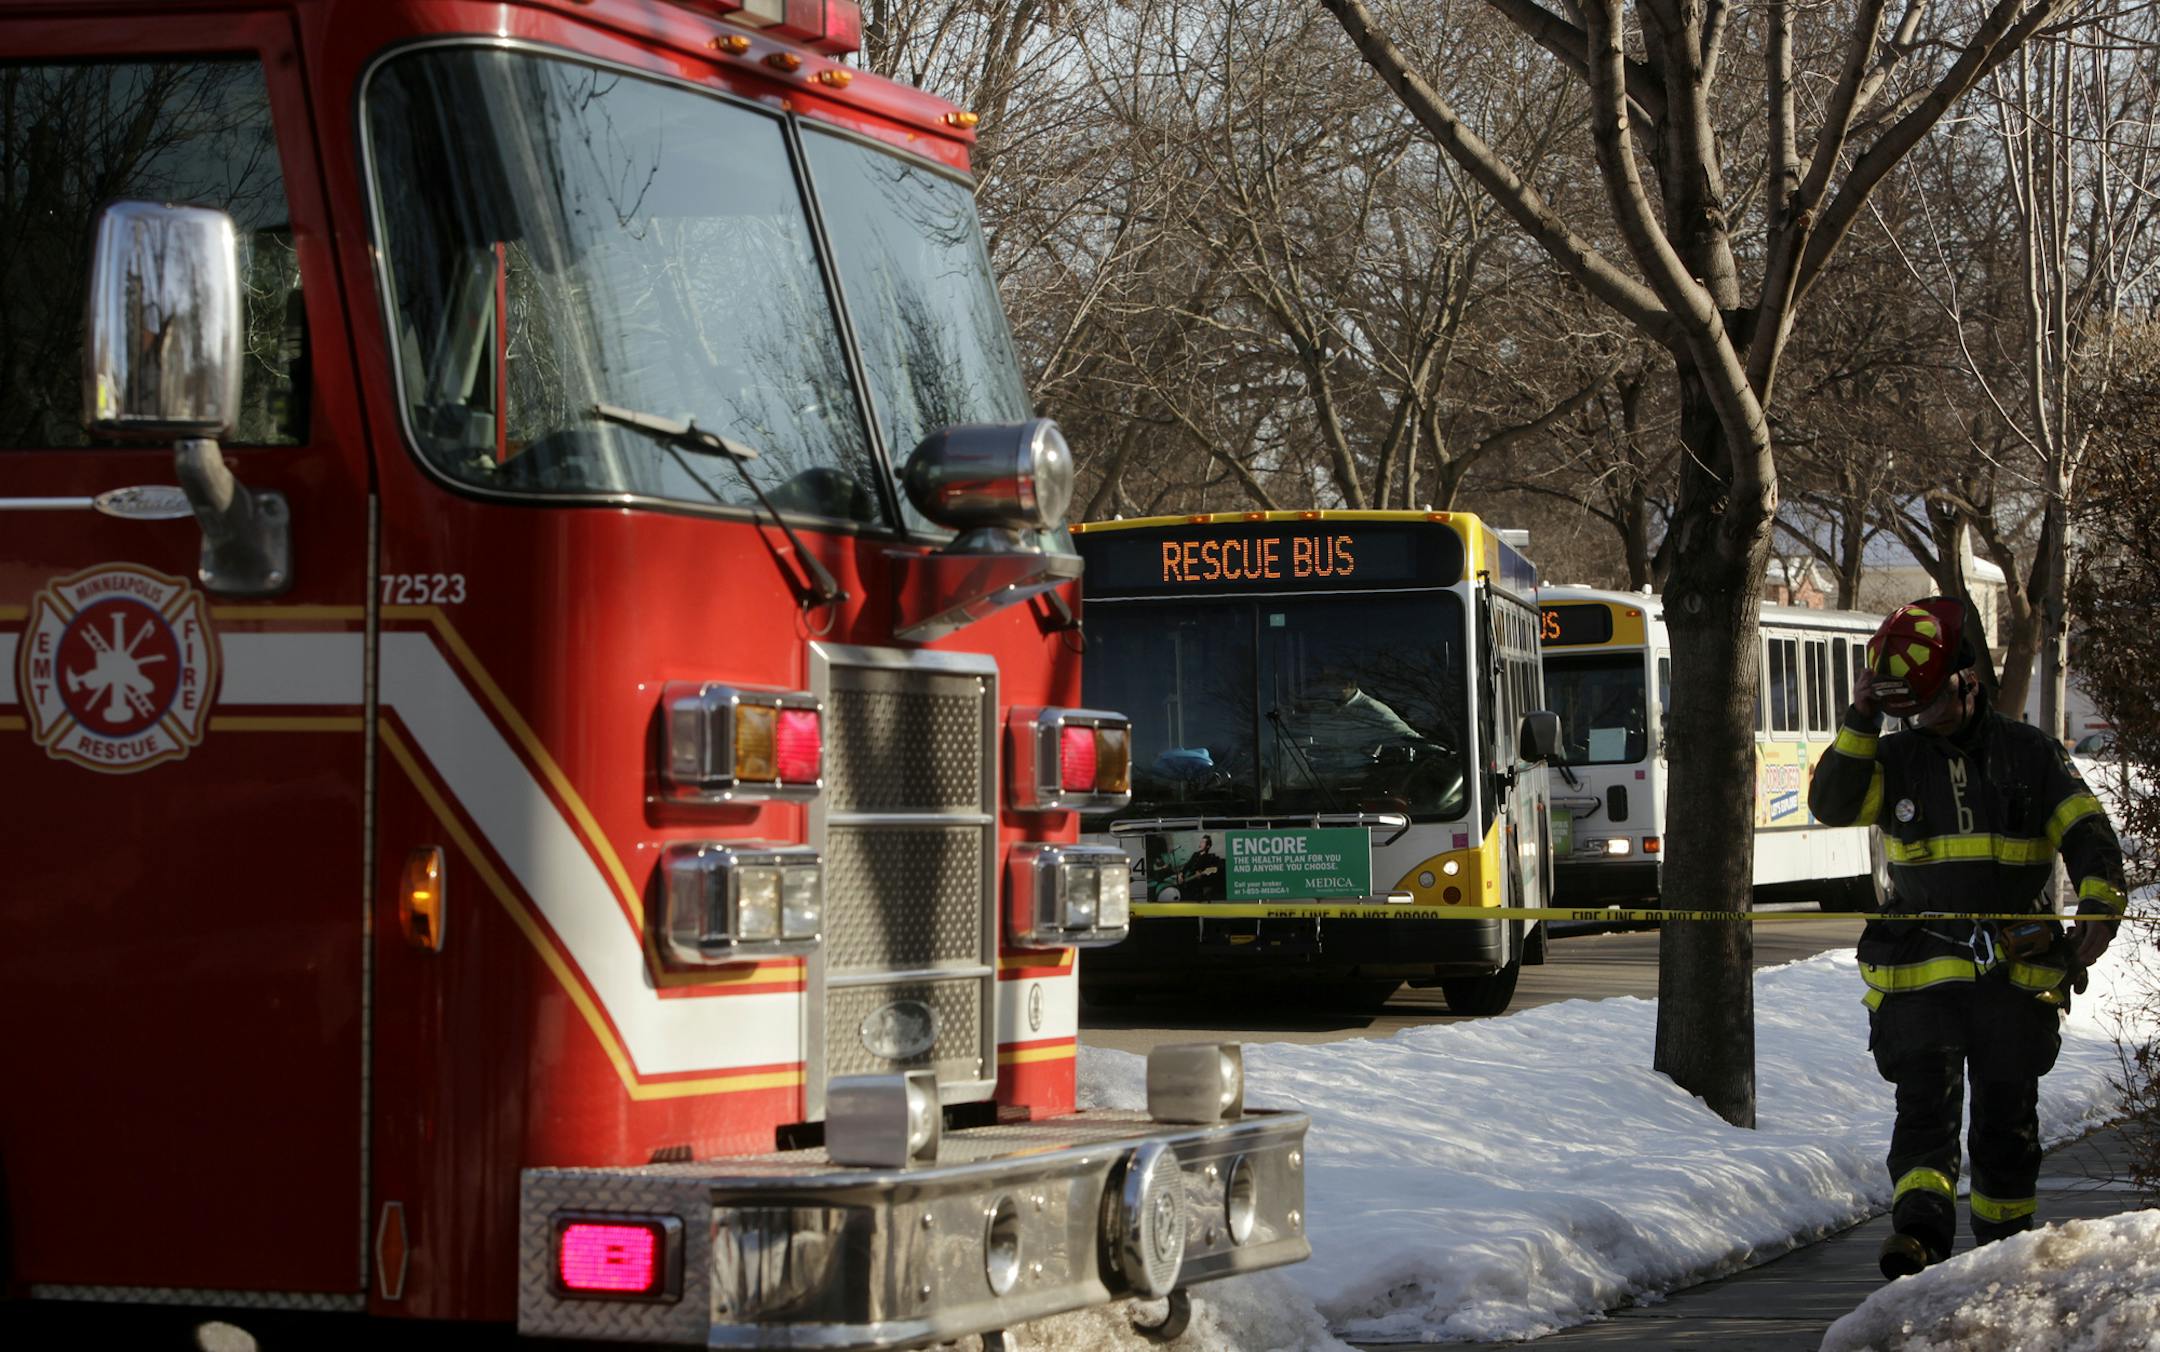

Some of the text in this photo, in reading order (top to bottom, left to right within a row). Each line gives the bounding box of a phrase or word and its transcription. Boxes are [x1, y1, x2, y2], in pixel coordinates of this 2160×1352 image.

[1162, 535, 1354, 582] RESCUE BUS
[75, 575, 163, 600] MINNEAPOLIS
[380, 574, 466, 604] 72523
[33, 632, 51, 705] EMT
[183, 620, 196, 711] FIRE
[78, 735, 157, 760] RESCUE
[1232, 836, 1308, 856] ENCORE
[1233, 864, 1251, 873] AND
[1252, 863, 1284, 872] ANYONE
[1286, 863, 1302, 871] YOU
[1234, 853, 1342, 865] THE HEALTH PLAN FOR YOU
[1305, 876, 1353, 888] MEDICA
